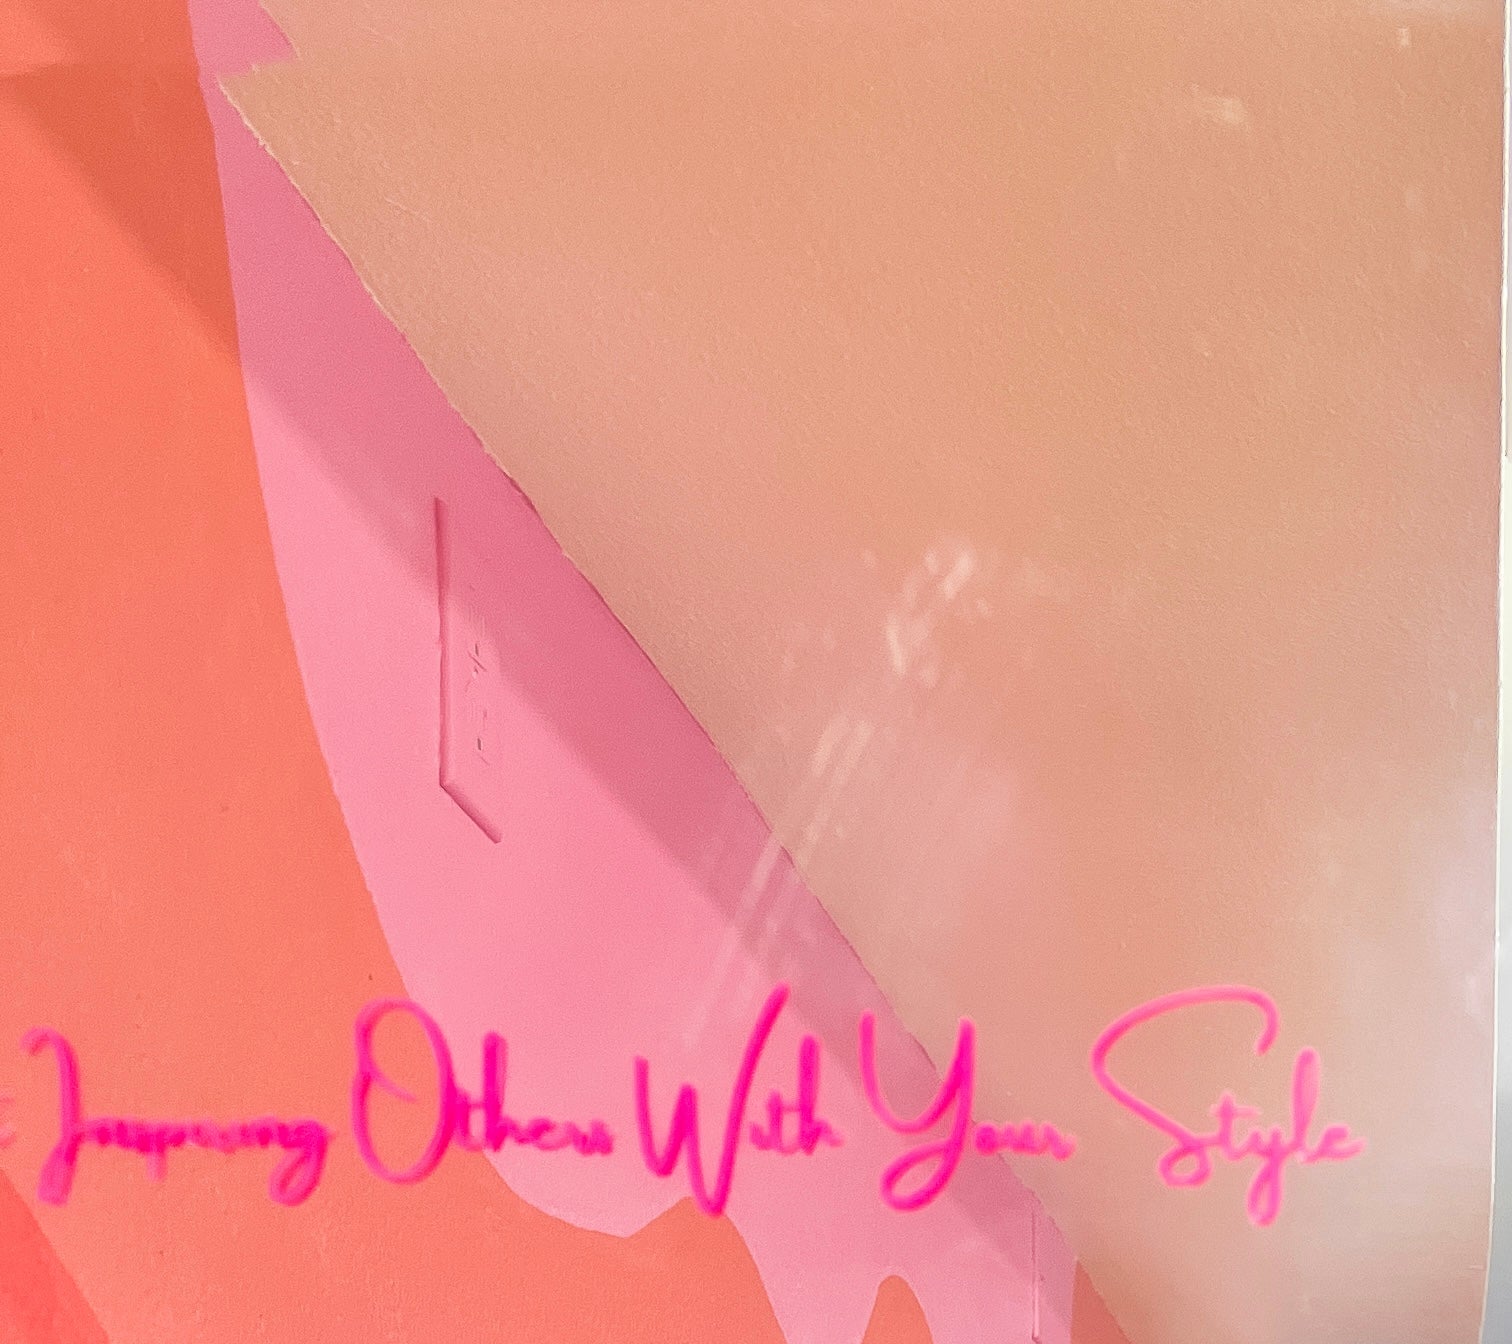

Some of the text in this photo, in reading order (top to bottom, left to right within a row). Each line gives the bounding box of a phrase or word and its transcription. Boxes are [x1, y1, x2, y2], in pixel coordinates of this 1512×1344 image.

[351, 1000, 613, 1184] Others
[634, 982, 845, 1217] With
[858, 1010, 1075, 1212] Your
[1091, 985, 1365, 1227] Style
